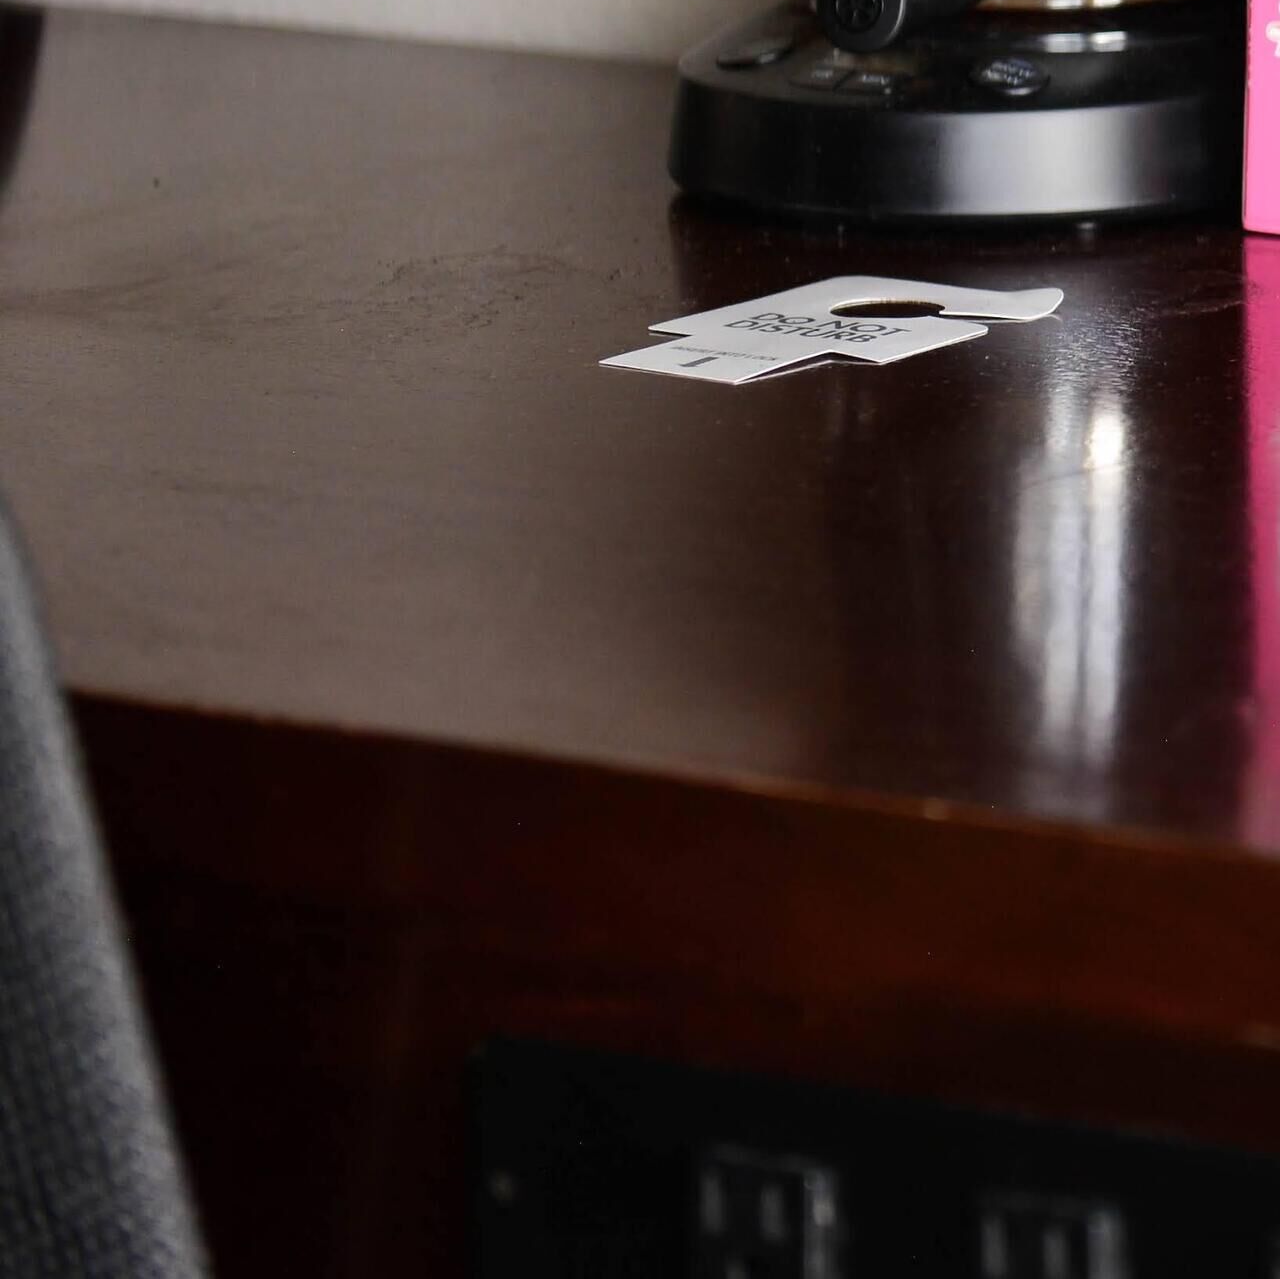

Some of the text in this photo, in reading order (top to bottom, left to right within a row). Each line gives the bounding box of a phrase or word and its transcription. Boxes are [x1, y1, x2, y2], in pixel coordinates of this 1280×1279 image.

[723, 319, 878, 343] DISTURB
[751, 312, 912, 338] DO NOT
